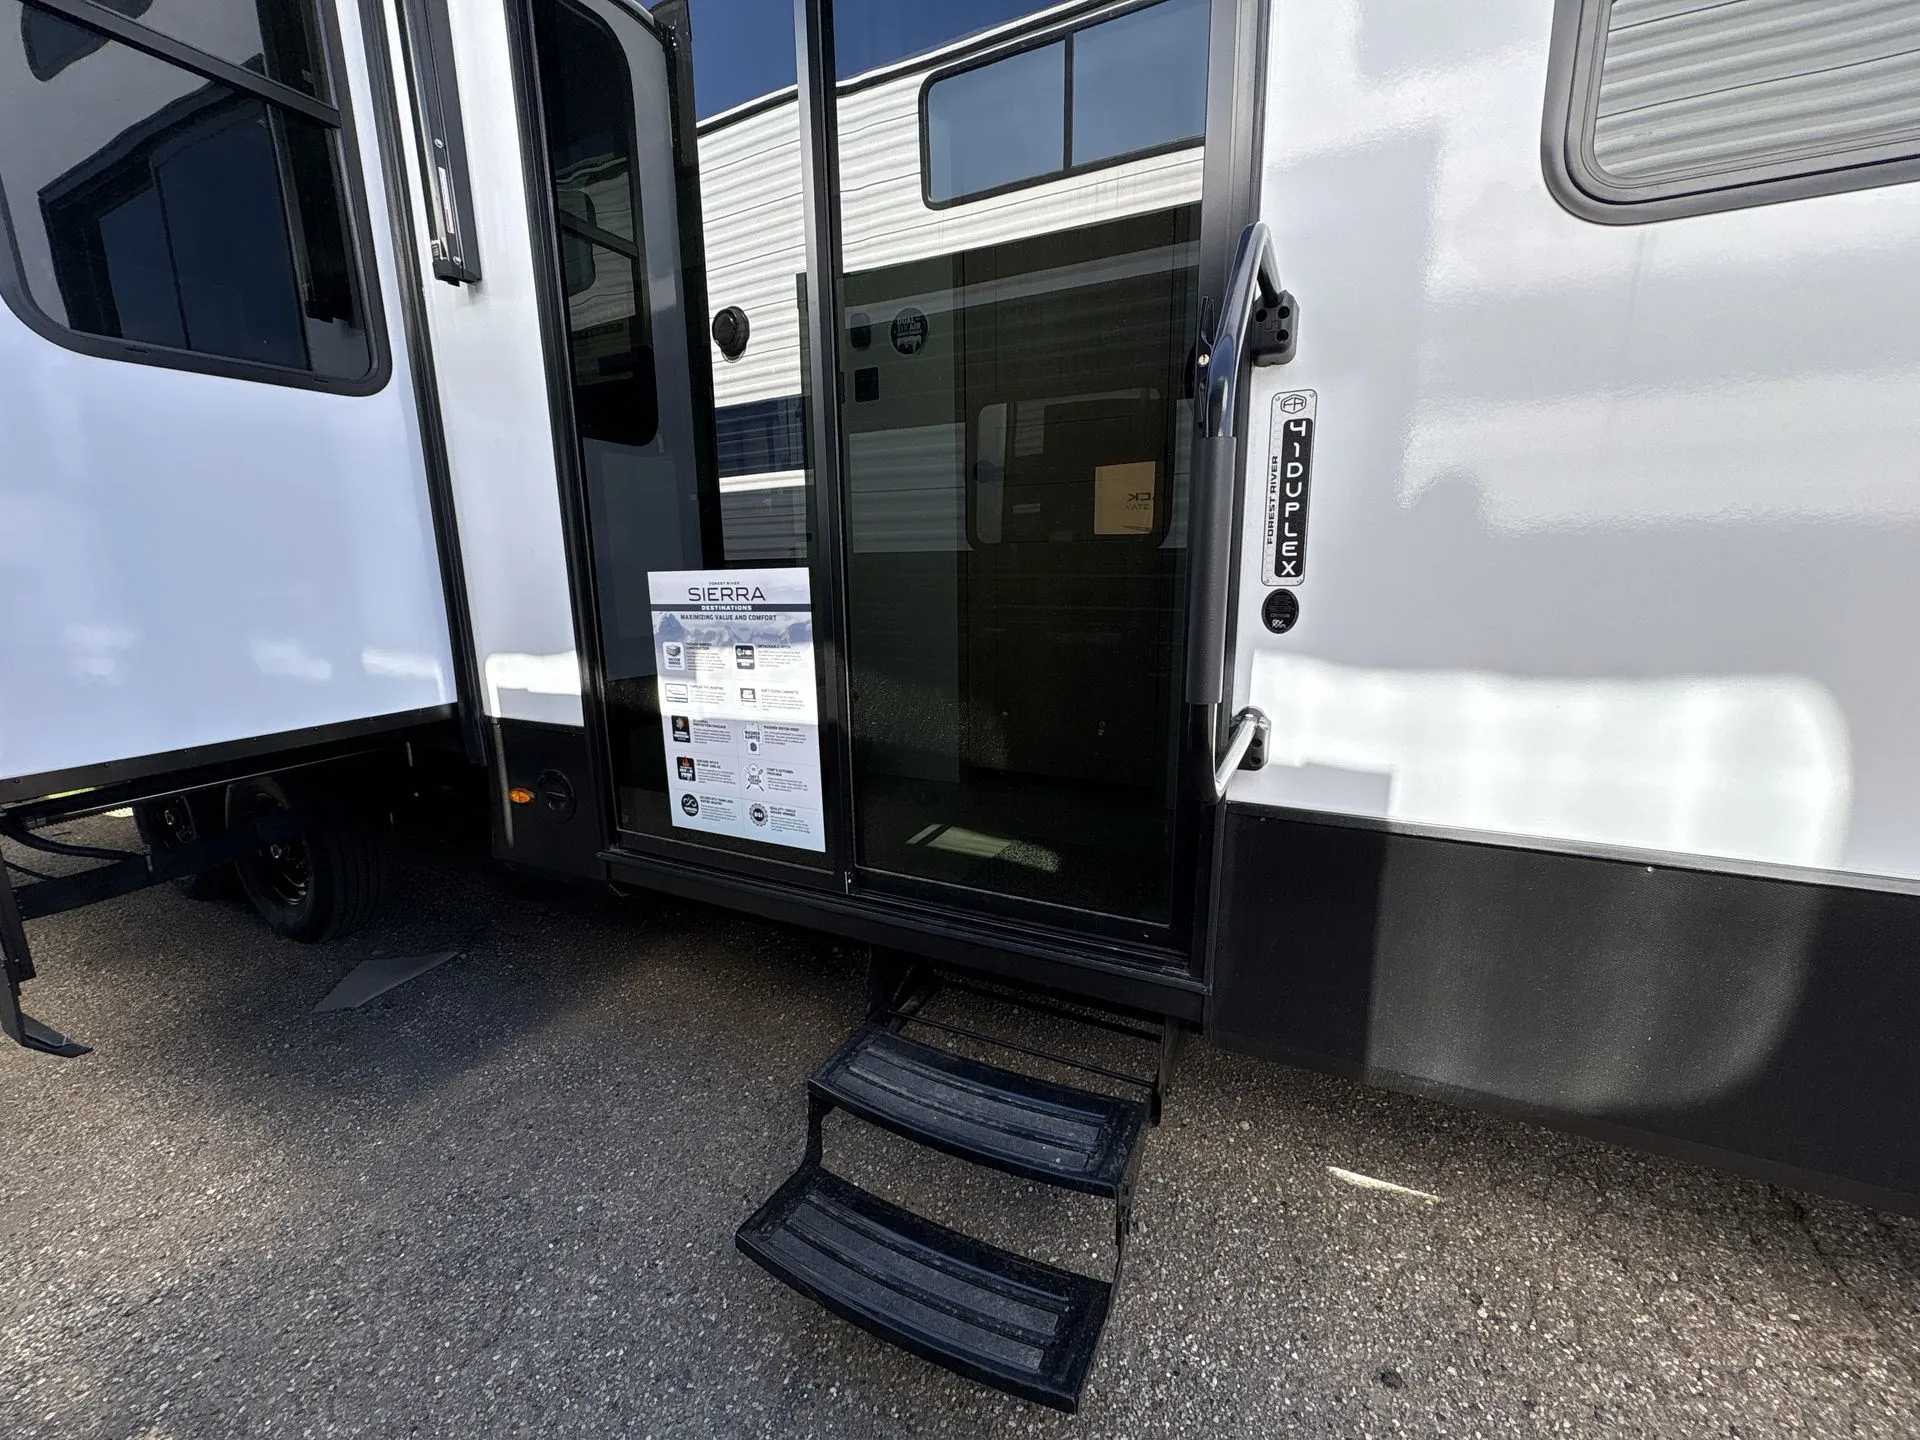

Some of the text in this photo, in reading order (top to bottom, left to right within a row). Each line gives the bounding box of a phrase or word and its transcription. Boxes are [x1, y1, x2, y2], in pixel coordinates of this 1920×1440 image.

[1267, 455, 1279, 545] FOREST RIVER
[688, 586, 766, 602] SIERRA
